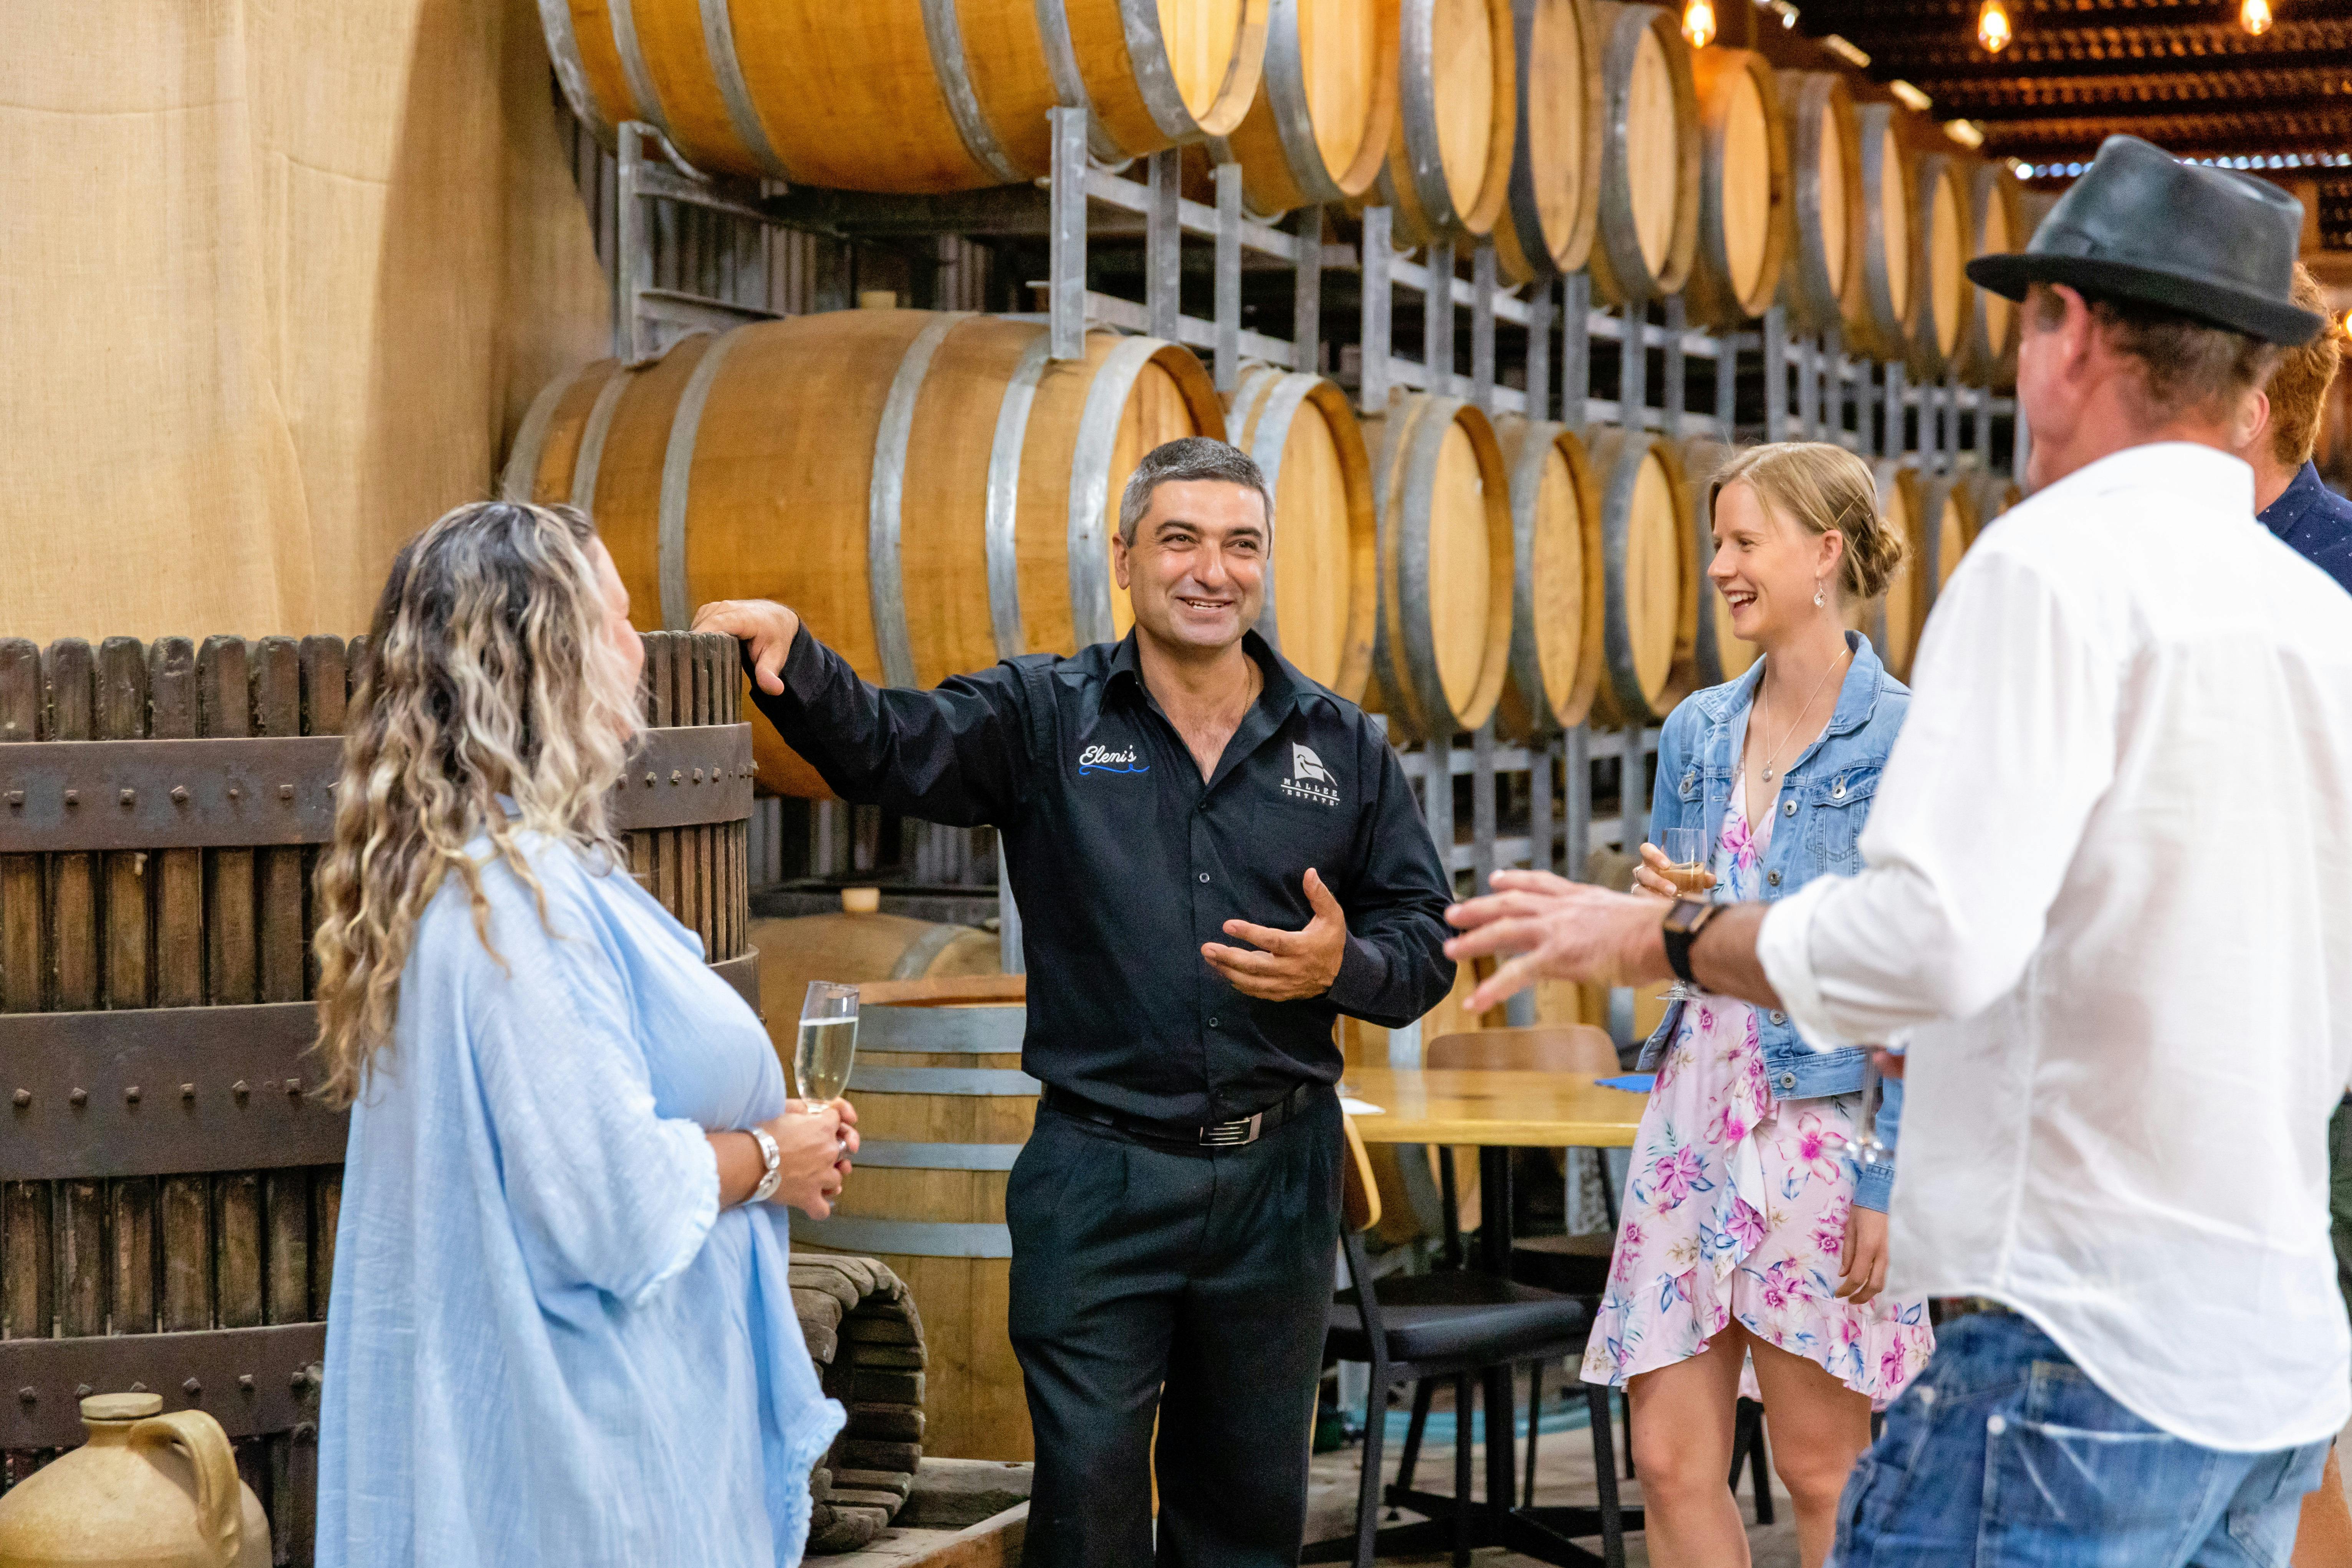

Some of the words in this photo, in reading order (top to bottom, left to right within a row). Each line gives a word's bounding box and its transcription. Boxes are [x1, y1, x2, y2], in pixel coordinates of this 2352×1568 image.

[1079, 745, 1137, 765] Eleni's
[1284, 778, 1337, 797] MALLEE
[1287, 789, 1334, 806] ESTATE
